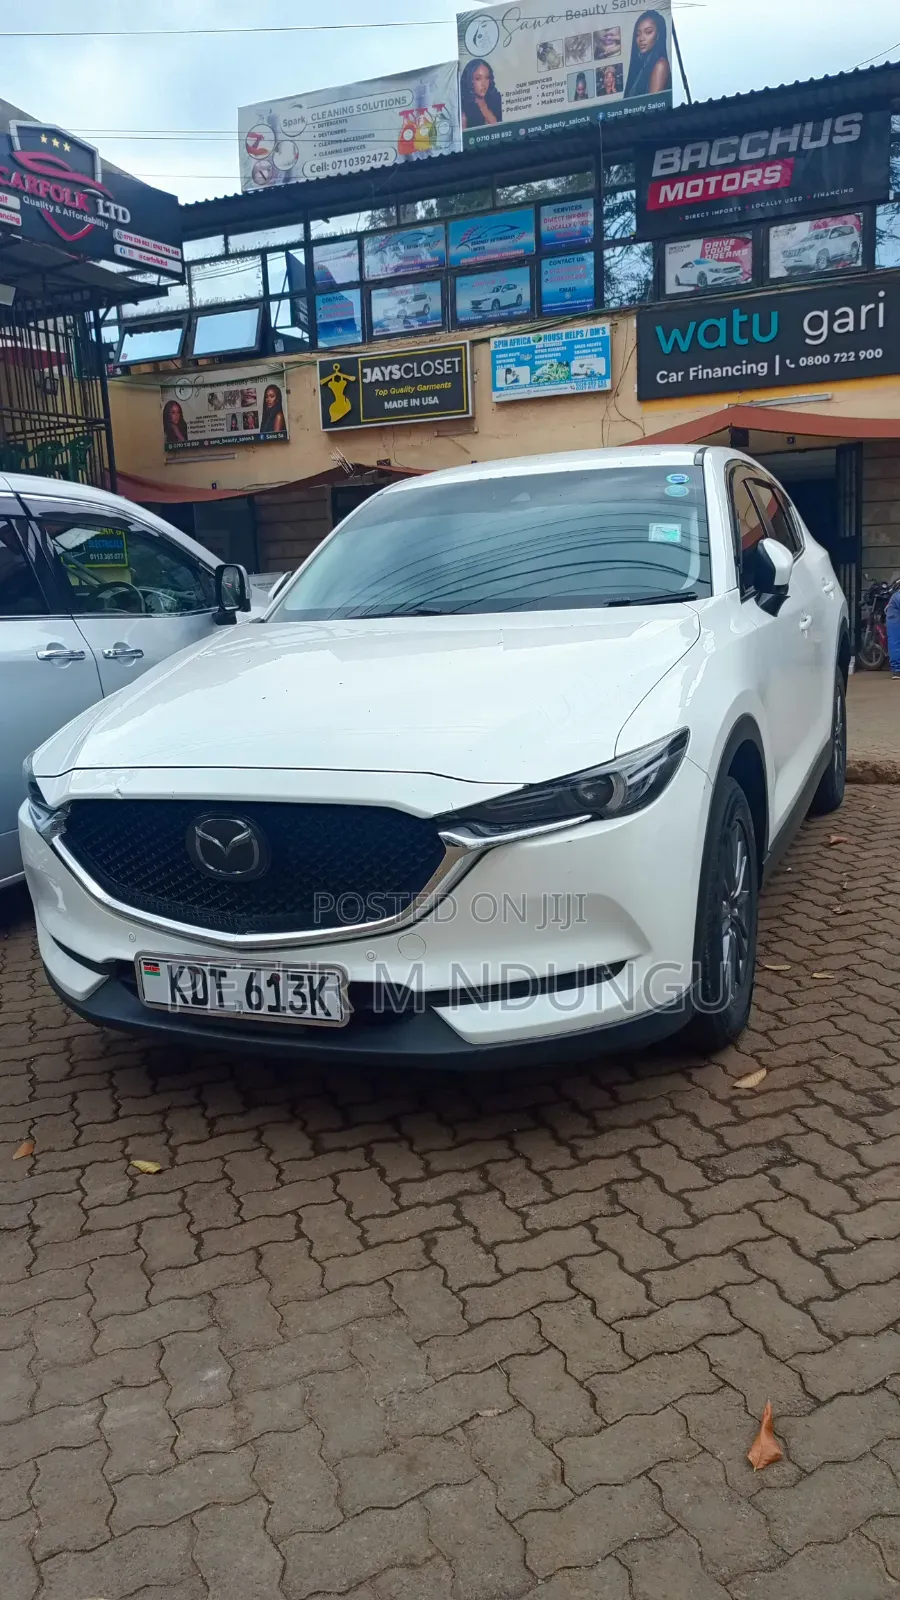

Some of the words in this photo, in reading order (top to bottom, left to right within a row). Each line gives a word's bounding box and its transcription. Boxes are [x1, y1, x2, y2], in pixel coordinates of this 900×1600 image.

[502, 7, 561, 47] Sana
[566, 4, 608, 21] Beauty
[612, 0, 646, 10] Salon
[528, 77, 552, 86] SERVICES
[541, 80, 567, 89] Overlays
[506, 88, 531, 97] Braiding
[541, 89, 565, 98] Acrylics
[506, 95, 532, 105] Manicure
[541, 97, 565, 105] Makeup
[283, 116, 306, 129] Spark
[311, 106, 354, 122] CLEANING
[356, 96, 407, 113] SOLUTIONS
[506, 104, 532, 112] Pedicure
[607, 109, 622, 118] Sana
[623, 105, 646, 115] Beauty
[647, 101, 666, 110] Salon
[318, 119, 348, 128] DETERGENTS
[476, 135, 490, 143] 0710
[319, 148, 342, 157] CLEANING
[343, 144, 366, 153] SERVICES
[652, 113, 863, 177] BACCHUS
[310, 163, 329, 174] Cell:
[332, 152, 389, 171] 0710392472
[659, 165, 782, 204] MOTORS
[553, 204, 582, 213] SERVICES
[685, 212, 709, 220] DIRECT
[712, 207, 741, 217] IMPORTS
[752, 200, 782, 210] LOCALLY
[784, 196, 803, 204] USED
[813, 188, 854, 199] FINANCING
[23, 195, 54, 213] Quality
[55, 206, 61, 214] &
[63, 208, 109, 229] Affordability
[96, 199, 131, 224] LTD
[543, 215, 564, 223] DIRECT
[547, 223, 571, 232] LOCALLY
[705, 239, 736, 249] DRIVE
[705, 246, 731, 254] YOUR
[705, 249, 748, 259] DREAMS
[549, 257, 574, 267] CONTACT
[655, 308, 779, 354] watu
[803, 290, 886, 345] gari
[494, 340, 508, 349] SPIN
[509, 337, 531, 346] AFRICA
[543, 333, 564, 342] HOUSE
[565, 330, 584, 340] HELPS
[363, 357, 461, 383] JAYSCLOSET
[656, 370, 684, 384] Car
[690, 360, 768, 381] Financing
[799, 355, 830, 367] 0800
[834, 352, 855, 363] 722
[859, 348, 883, 361] 900
[250, 376, 268, 384] Salon
[390, 385, 415, 395] Quality
[417, 382, 451, 391] Garments
[384, 399, 408, 410] MADE
[410, 398, 420, 407] IN
[422, 396, 439, 405] USA
[167, 964, 227, 1007] KDT
[245, 971, 331, 1017] 613K
